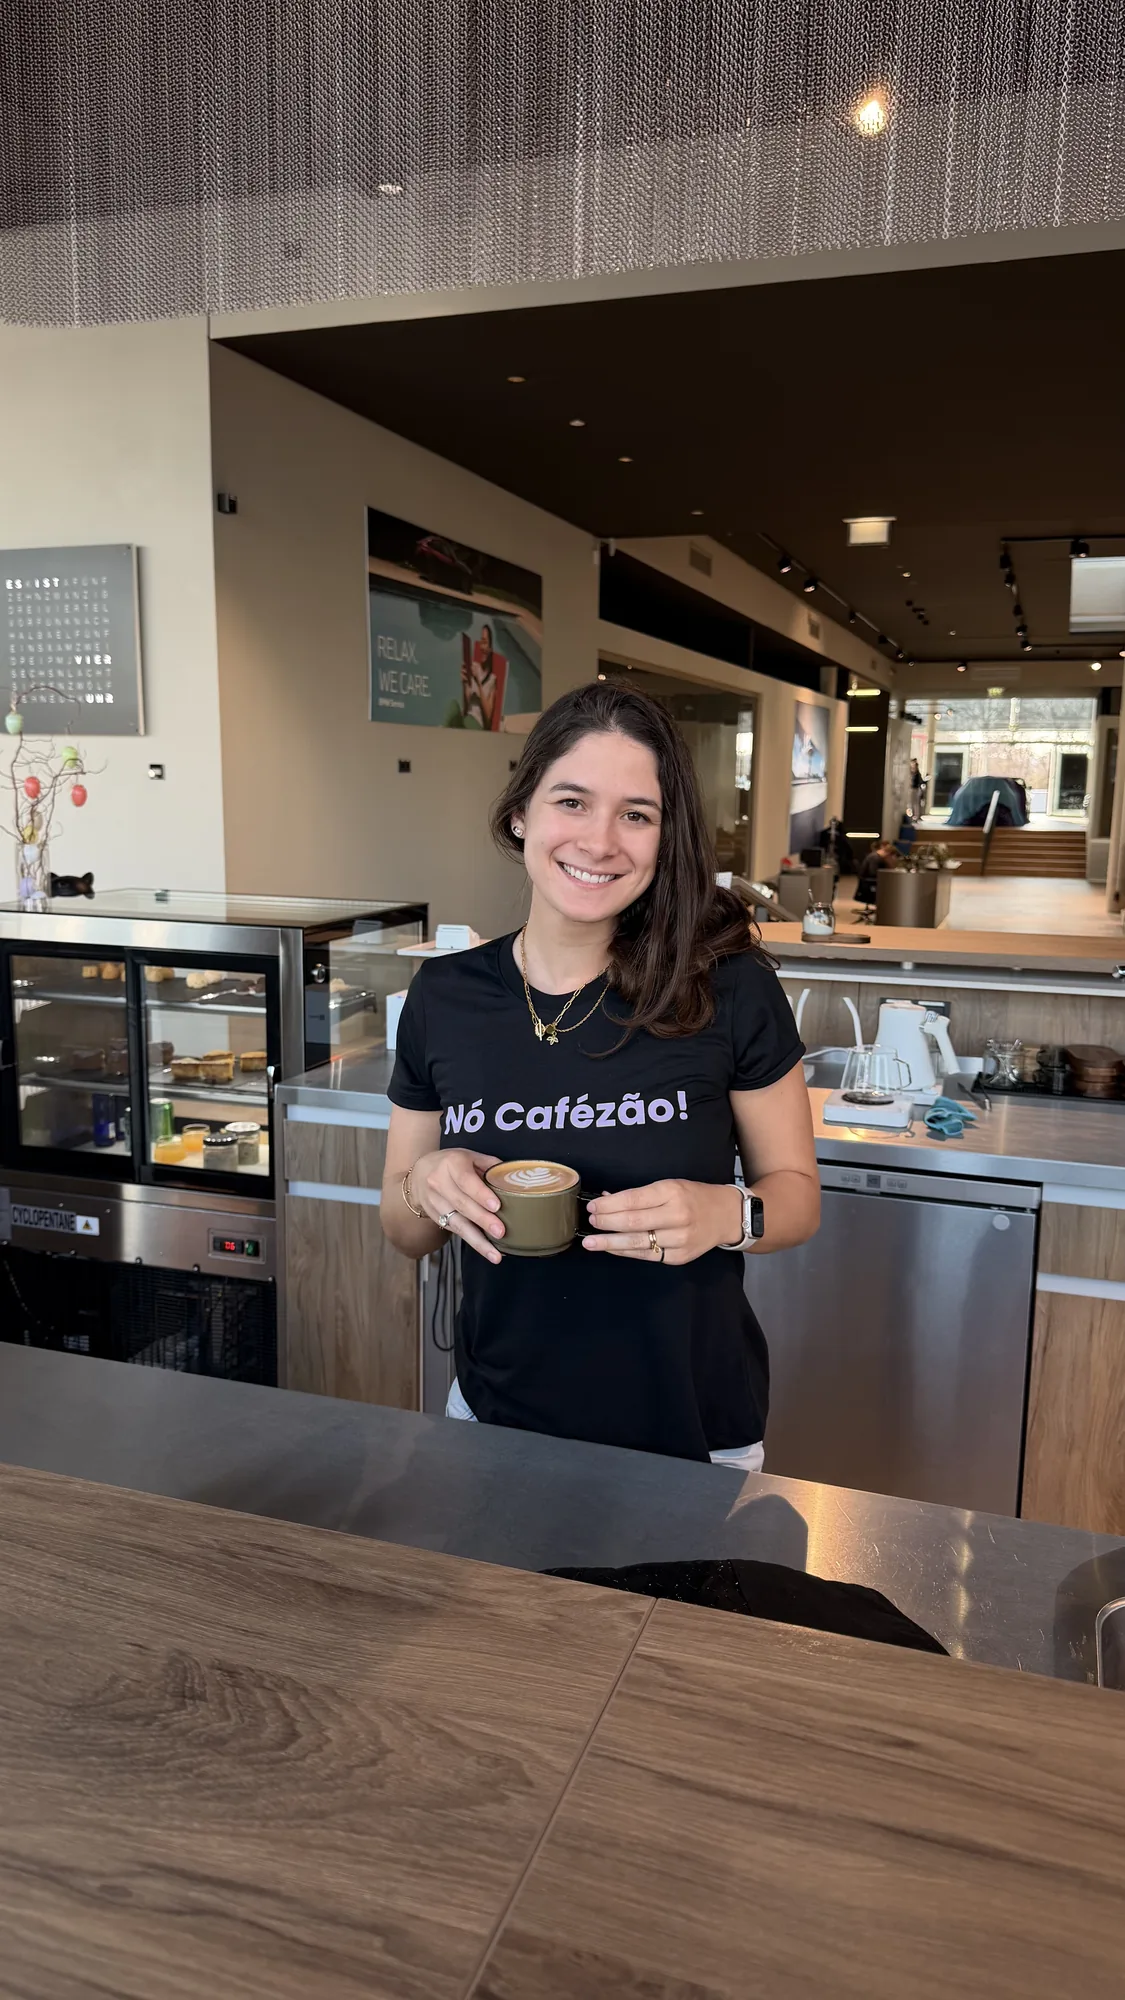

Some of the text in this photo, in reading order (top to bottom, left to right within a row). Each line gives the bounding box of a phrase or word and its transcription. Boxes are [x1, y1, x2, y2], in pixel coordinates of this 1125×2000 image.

[6, 579, 22, 590] ES
[34, 577, 60, 588] IST
[74, 654, 112, 665] VIER
[378, 668, 398, 693] WE
[85, 693, 114, 704] UHR
[444, 1090, 689, 1135] Nó Cafézão!
[12, 1206, 76, 1232] CYCLOPENTANE
